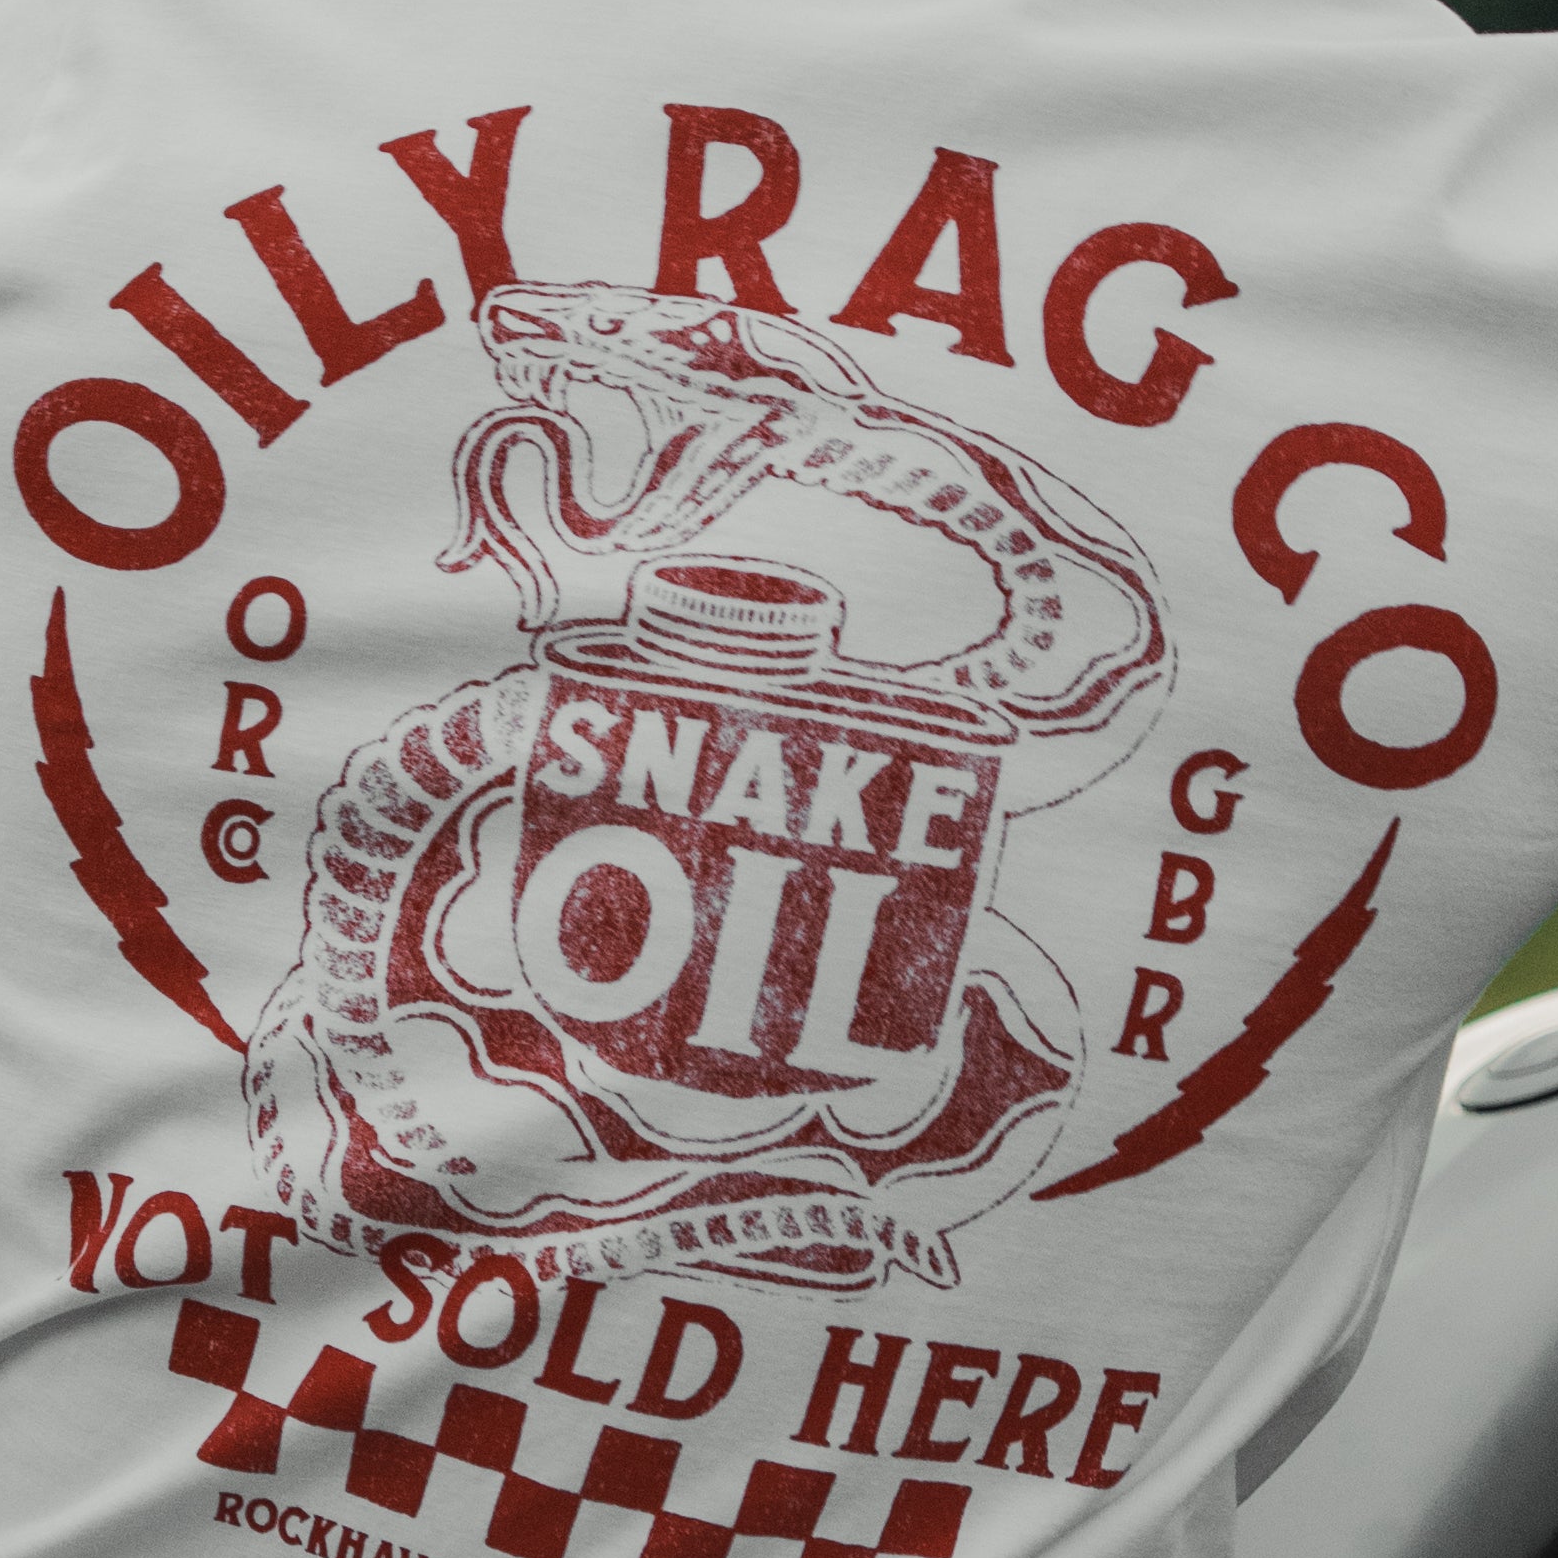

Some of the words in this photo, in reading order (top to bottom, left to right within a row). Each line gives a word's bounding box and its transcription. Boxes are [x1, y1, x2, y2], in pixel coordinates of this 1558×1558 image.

[12, 104, 533, 573] OILY
[648, 102, 1239, 428] RAG
[1231, 422, 1499, 791] CO
[533, 699, 980, 871] SNAKE
[1110, 748, 1250, 1062] GBR
[515, 824, 943, 1073] OIL
[62, 1170, 300, 1305] NOT
[362, 1232, 744, 1421] SOLD
[789, 1325, 1162, 1490] HERE
